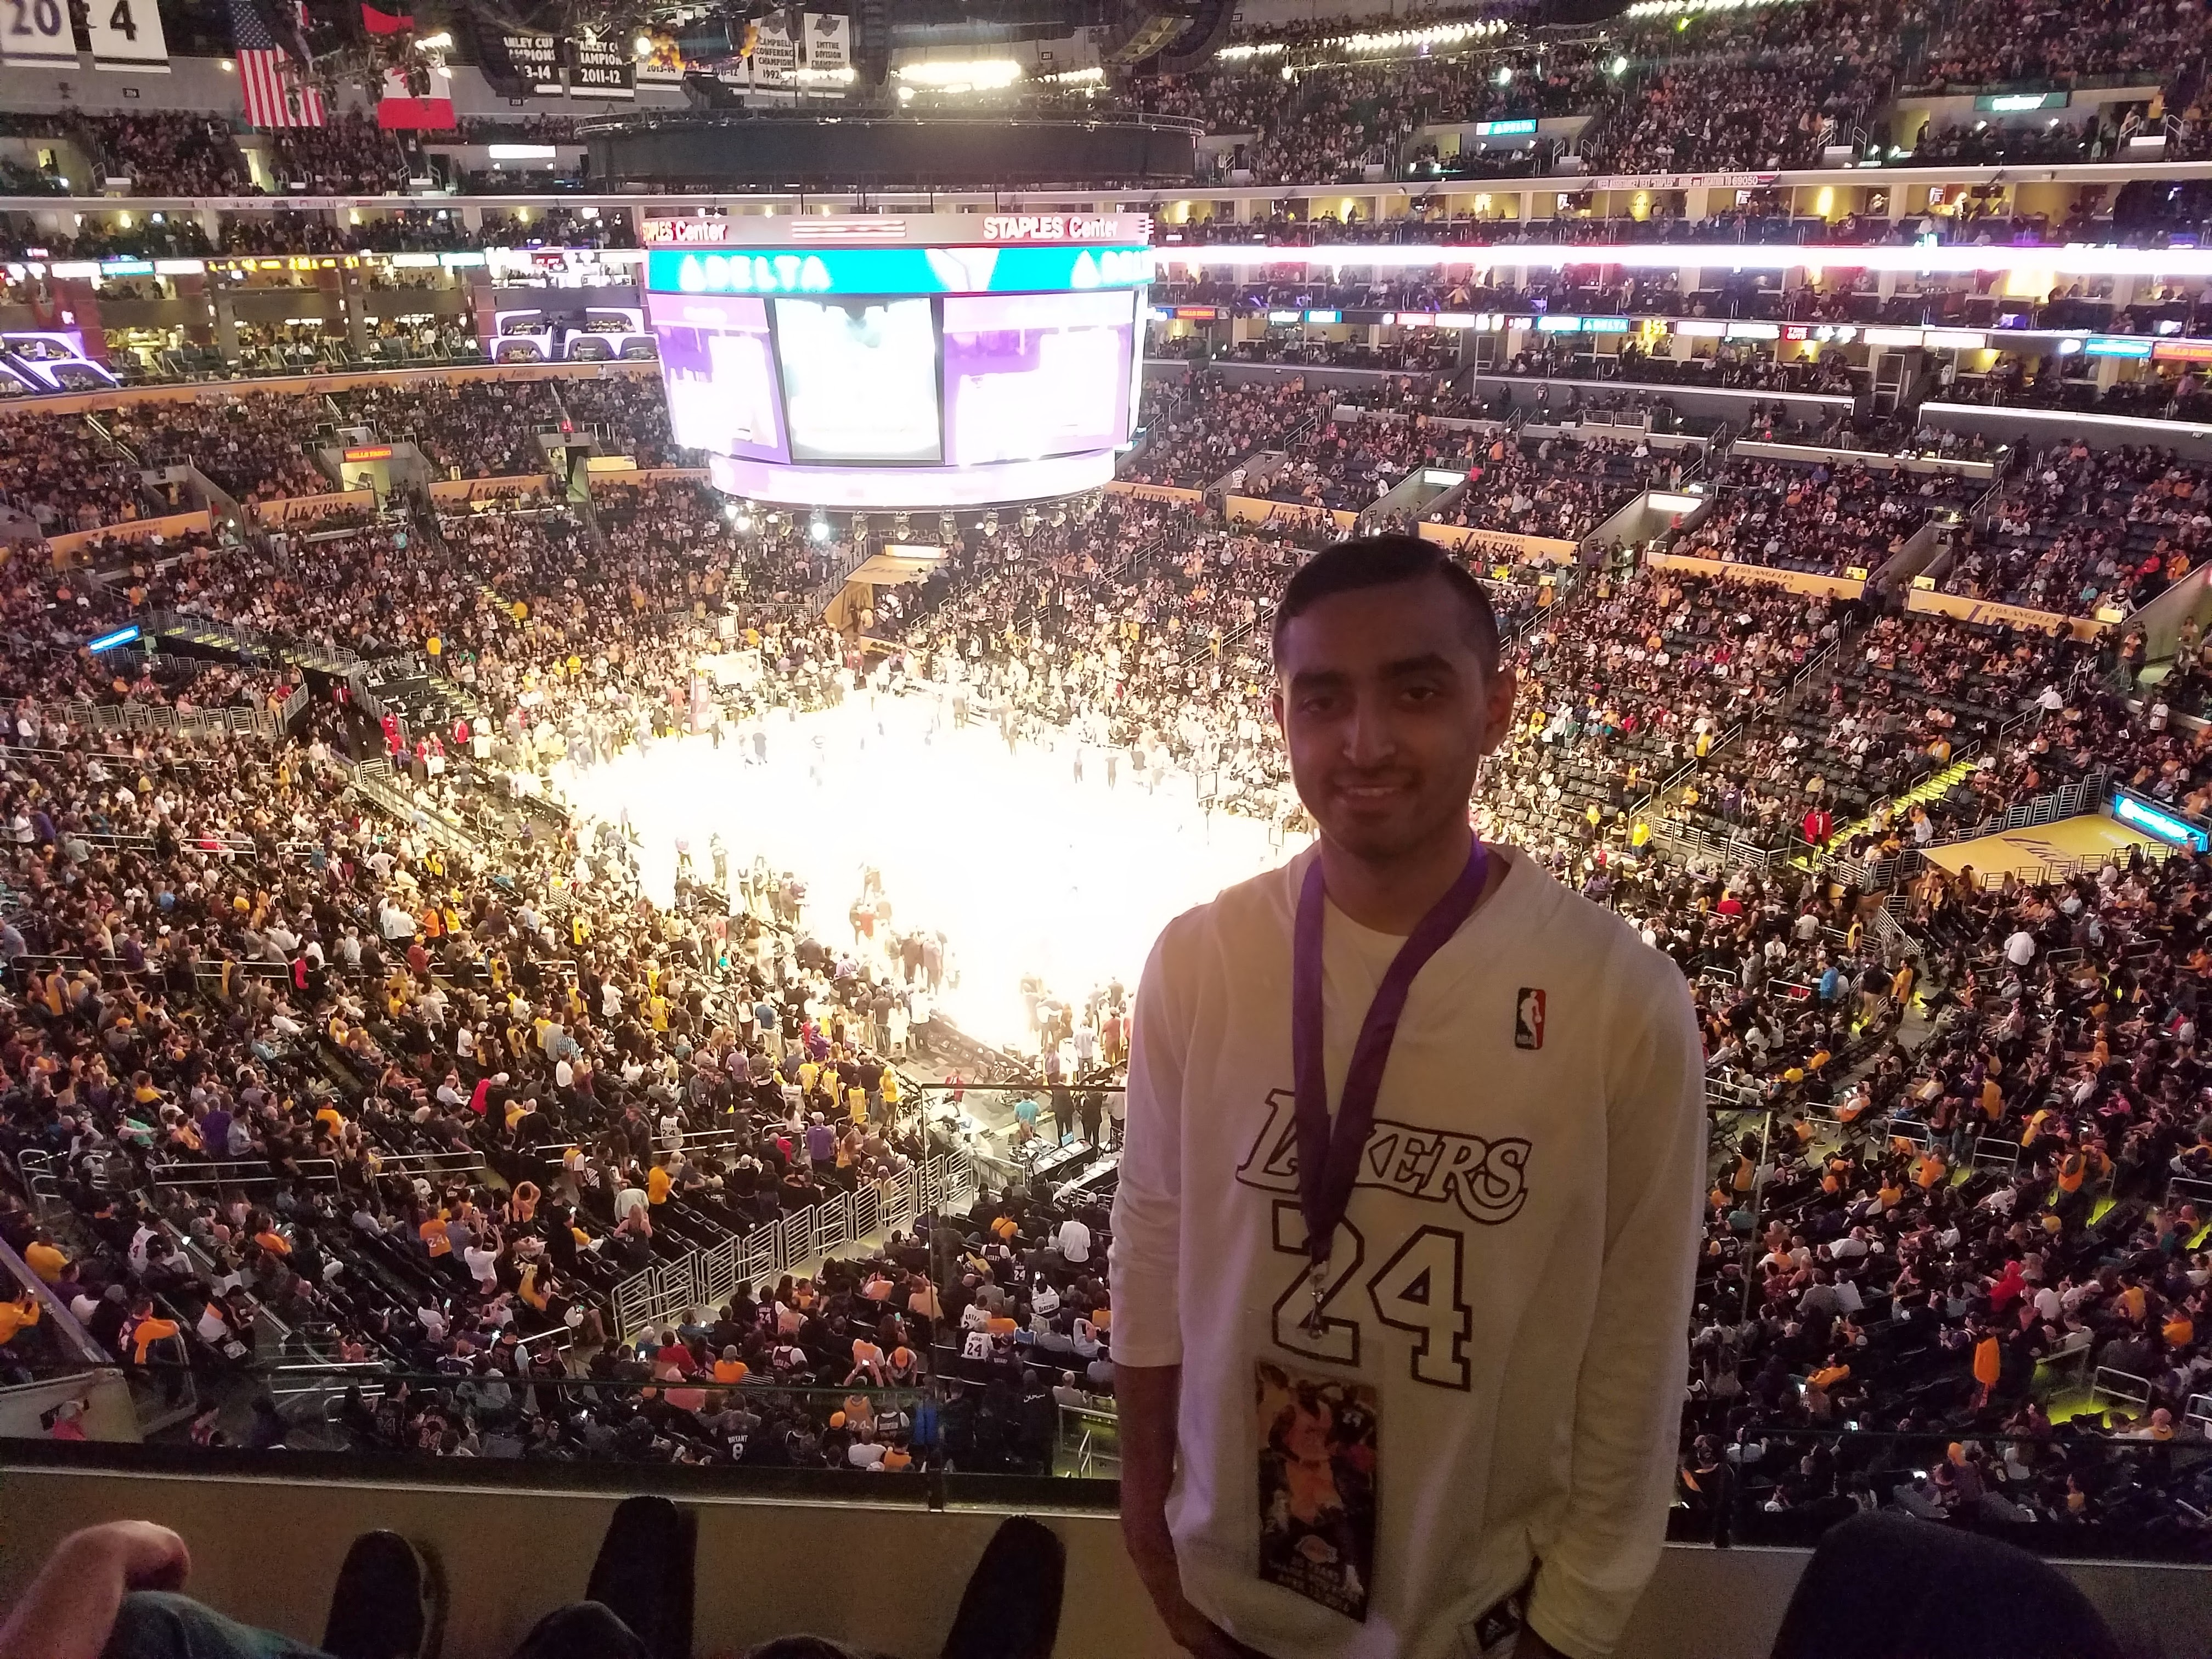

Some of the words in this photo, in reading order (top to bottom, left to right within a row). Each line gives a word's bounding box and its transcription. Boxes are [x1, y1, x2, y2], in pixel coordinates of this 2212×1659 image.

[7, 0, 61, 37] 20
[110, 0, 137, 41] 4
[514, 65, 551, 80] 3-14
[580, 68, 621, 83] 2011-12
[1732, 176, 1759, 187] 69050
[675, 220, 727, 241] Center
[983, 216, 1064, 240] STAPLES
[1068, 216, 1118, 238] Center
[706, 255, 832, 290] DELTA
[1755, 569, 1795, 580] ANGELES
[1989, 606, 2007, 614] LOS
[2009, 610, 2058, 624] ANGELES
[427, 1234, 445, 1248] 24
[1014, 1270, 1026, 1281] 24
[1272, 1199, 1472, 1392] 24
[759, 1313, 772, 1324] 24
[968, 1342, 983, 1357] 24
[419, 1427, 443, 1451] 24
[727, 1435, 749, 1444] BRYANT
[732, 1443, 744, 1461] 8
